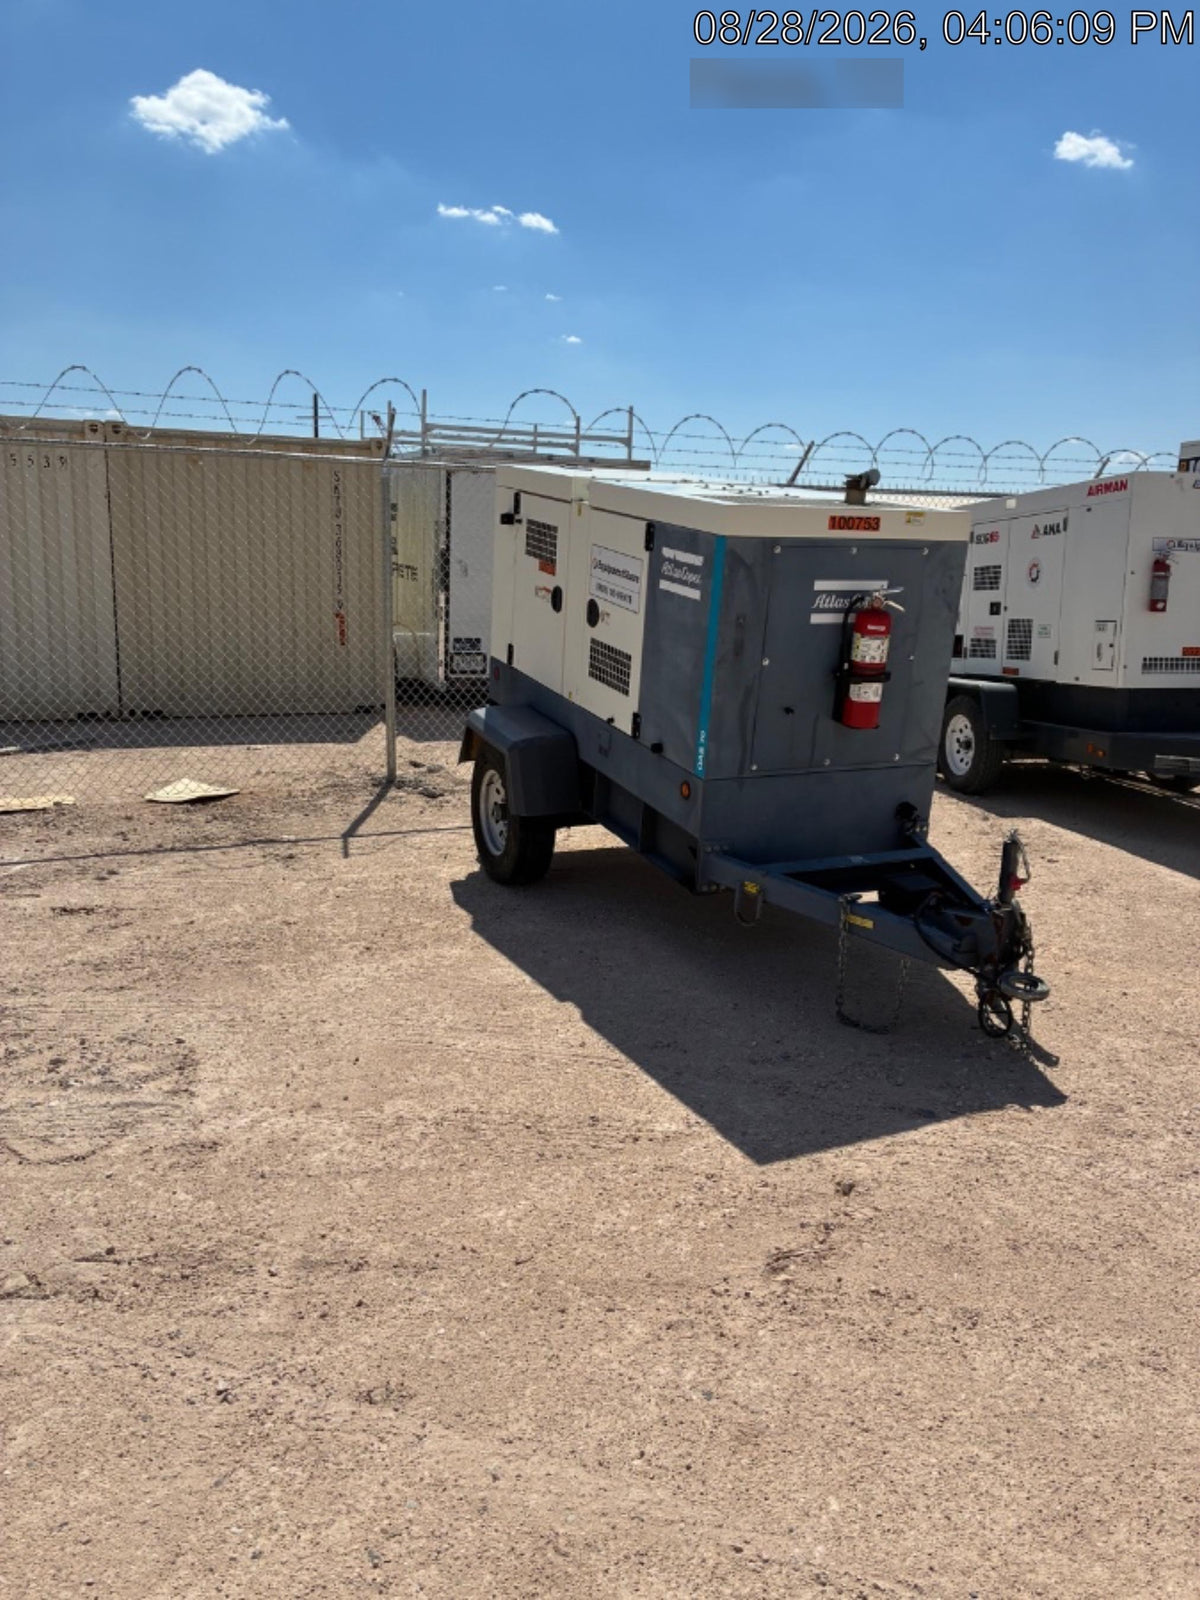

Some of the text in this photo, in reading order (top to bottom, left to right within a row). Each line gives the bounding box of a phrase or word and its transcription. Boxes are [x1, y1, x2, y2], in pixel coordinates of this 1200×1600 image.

[1087, 478, 1128, 497] AIRMAN
[829, 515, 881, 532] 100753
[811, 593, 850, 609] Atlas
